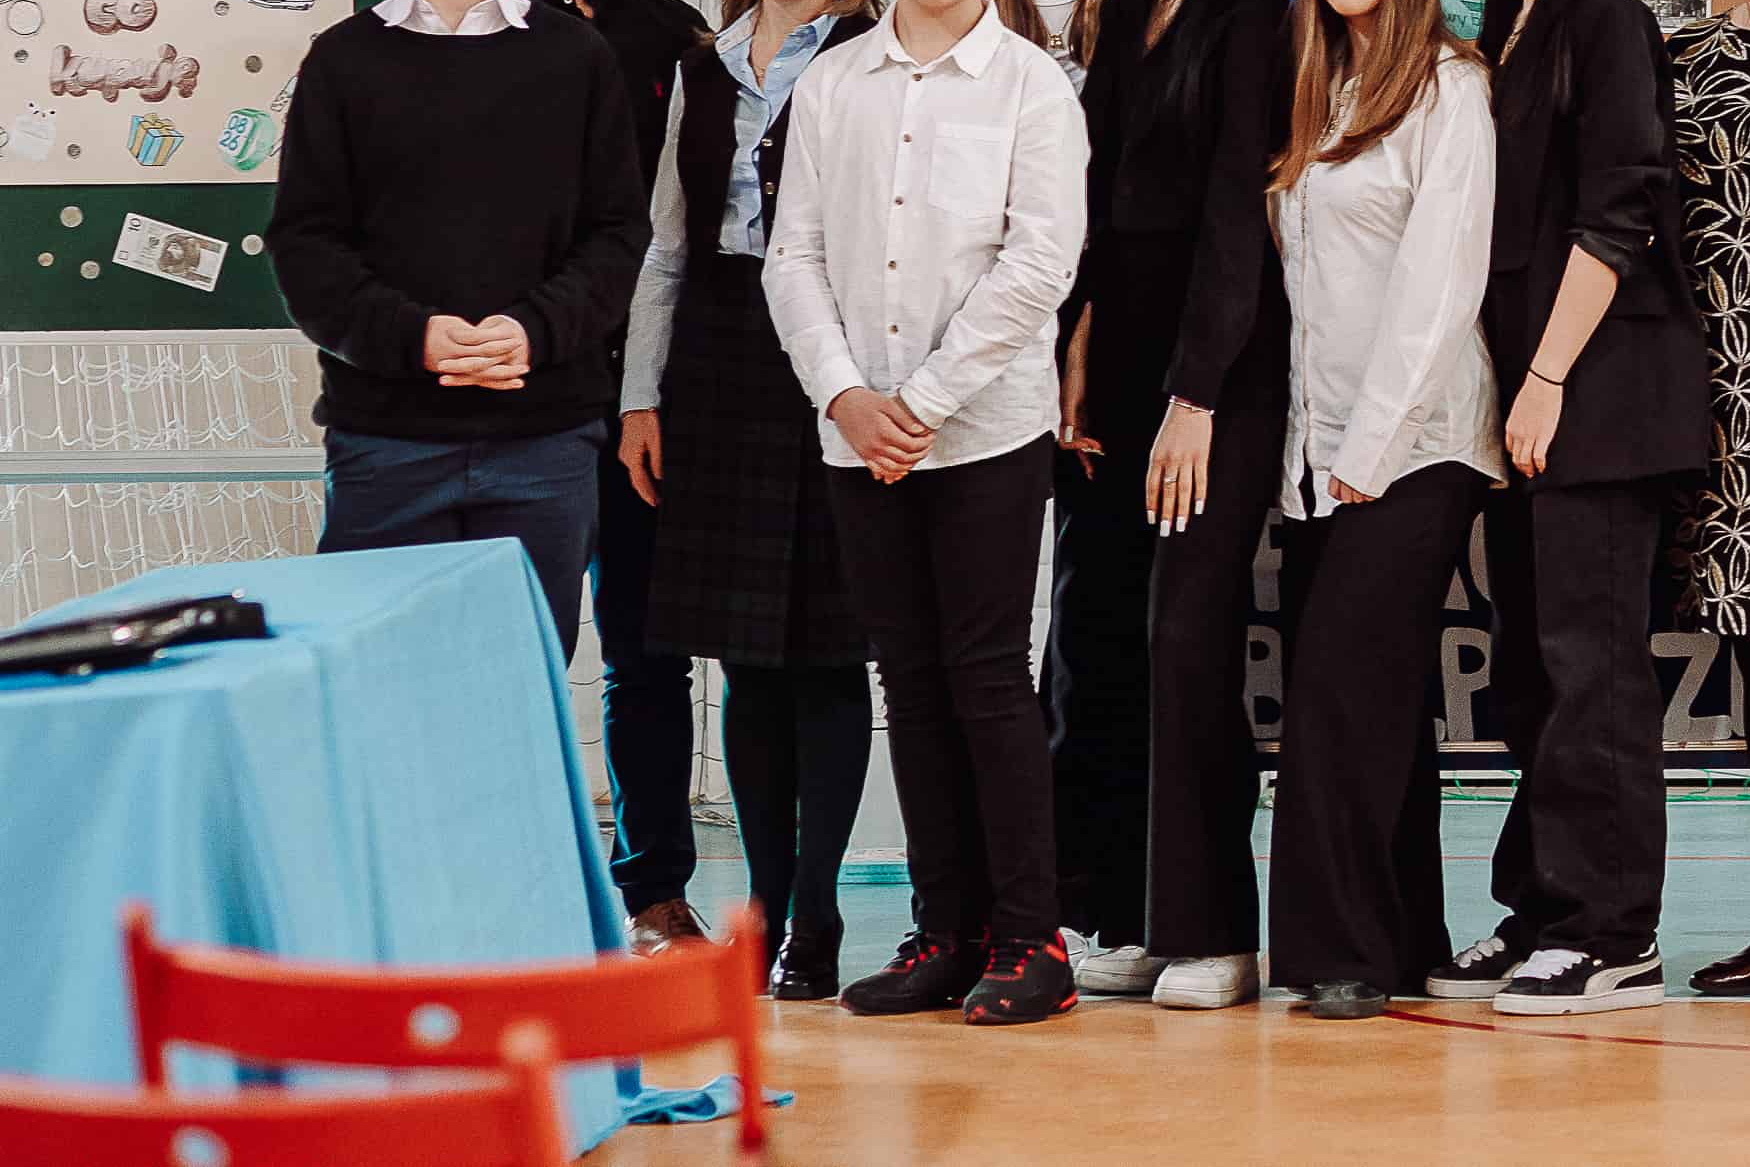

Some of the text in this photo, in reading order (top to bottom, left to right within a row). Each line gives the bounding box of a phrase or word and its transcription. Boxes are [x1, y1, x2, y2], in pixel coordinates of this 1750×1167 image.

[228, 114, 249, 134] 08
[219, 130, 241, 151] 26
[127, 217, 141, 232] 10
